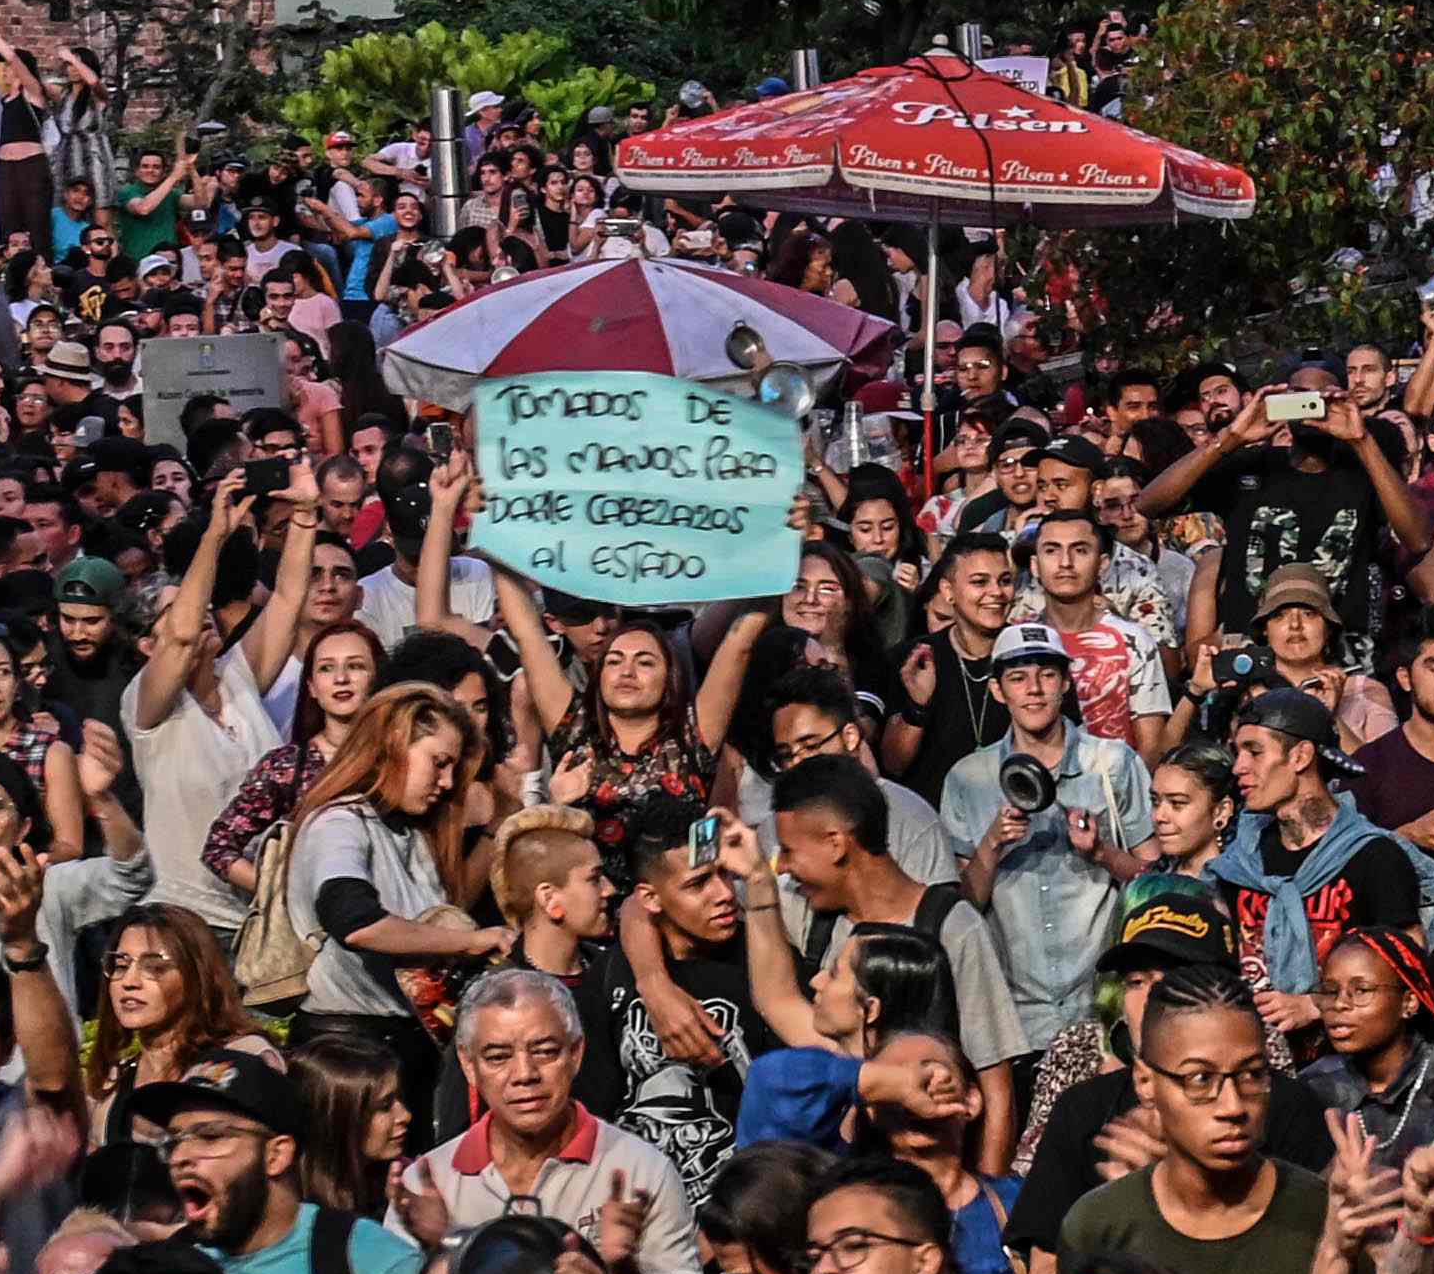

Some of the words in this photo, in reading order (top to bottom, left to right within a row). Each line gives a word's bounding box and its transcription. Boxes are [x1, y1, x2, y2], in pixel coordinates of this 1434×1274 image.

[891, 101, 1090, 133] Pilsen
[625, 146, 665, 166] Pilsen
[679, 147, 718, 167] Pilsen
[731, 146, 769, 167] Pilsen
[848, 144, 902, 170] Pilsen
[923, 153, 978, 178] Pilsen
[1000, 160, 1055, 183] Pilsen
[1077, 163, 1132, 185] Pilsen
[495, 384, 647, 425] TOMADOS
[685, 392, 732, 425] DE
[591, 541, 706, 583] ESTADO
